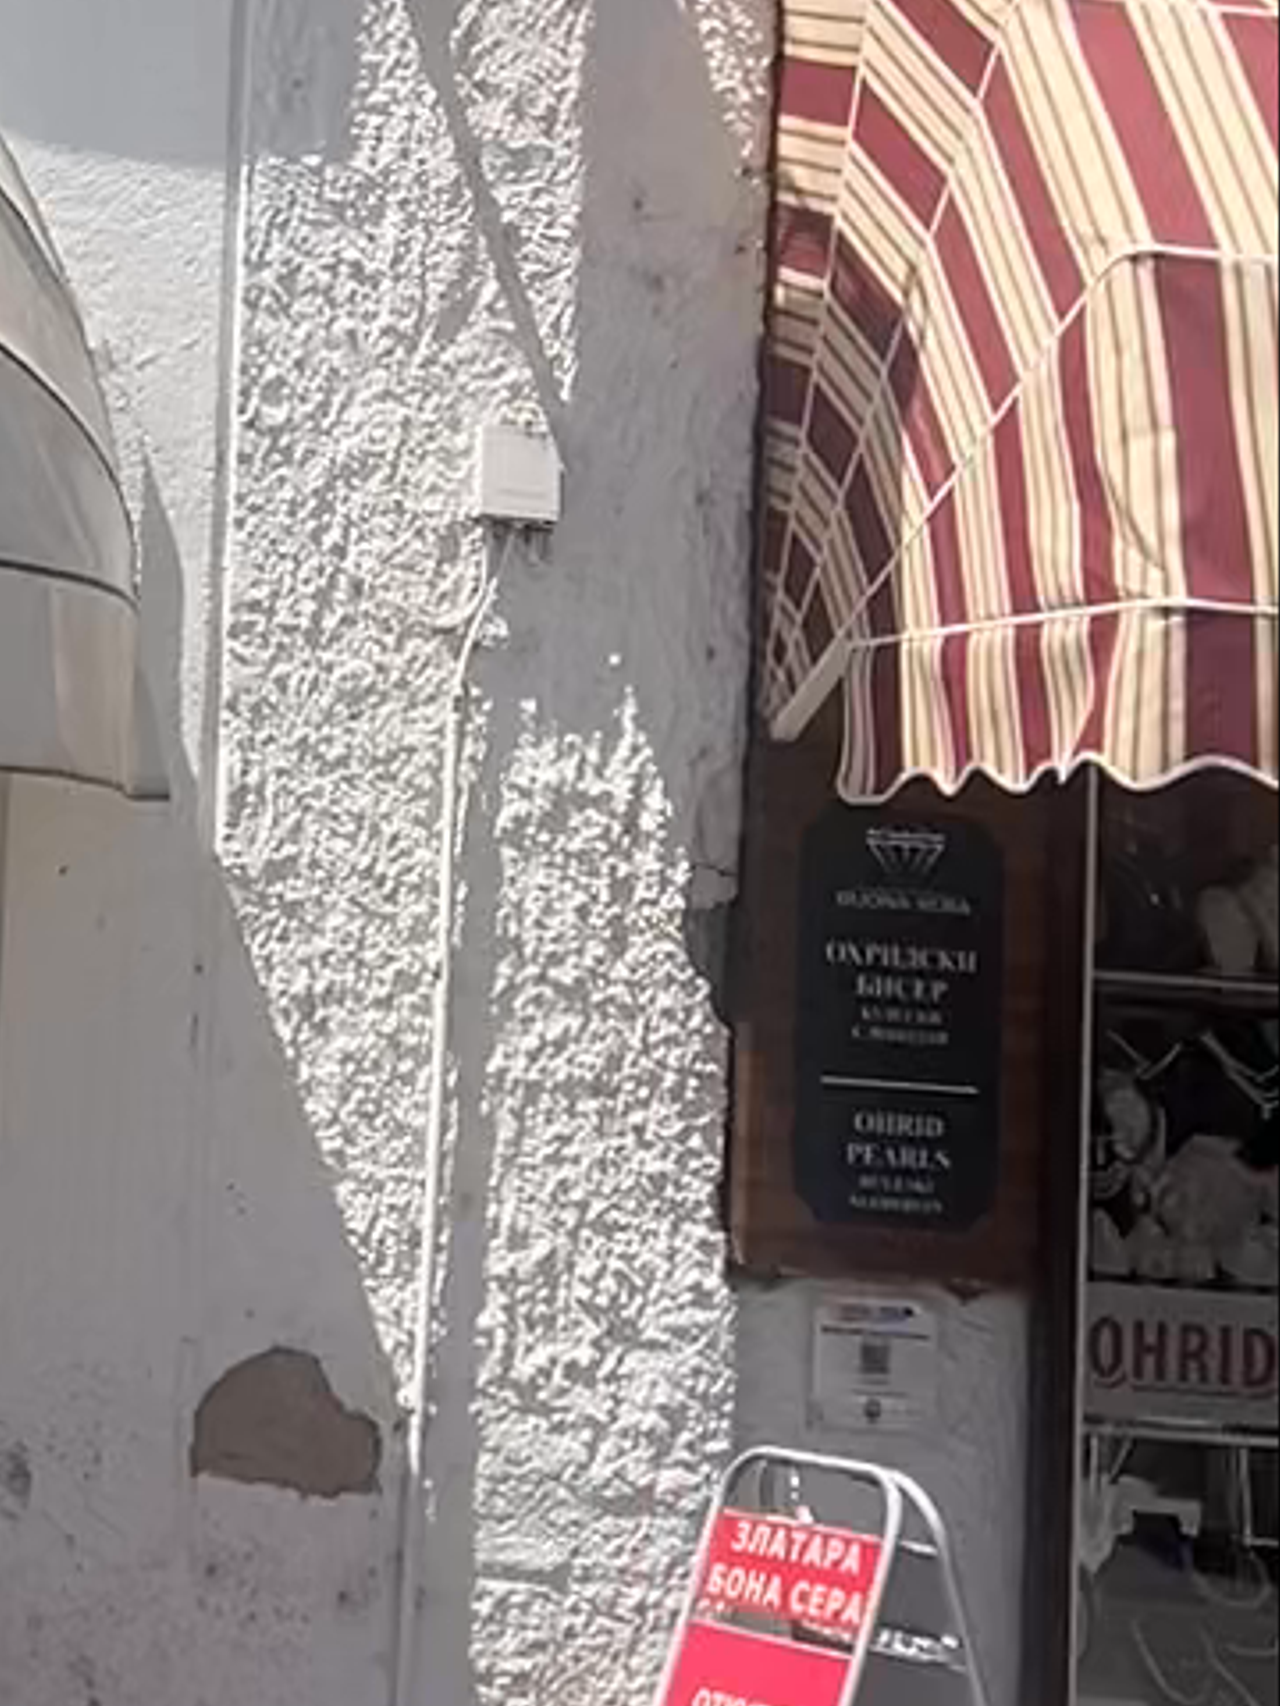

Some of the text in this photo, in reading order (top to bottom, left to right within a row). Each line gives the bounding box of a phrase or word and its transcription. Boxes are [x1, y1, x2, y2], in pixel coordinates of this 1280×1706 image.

[853, 1111, 943, 1136] OHRID
[846, 1142, 950, 1169] PEARLS
[1090, 1317, 1277, 1388] OHRID
[731, 1522, 860, 1575] ЗЛАТАРА
[707, 1564, 863, 1626] БОНА СЕРА
